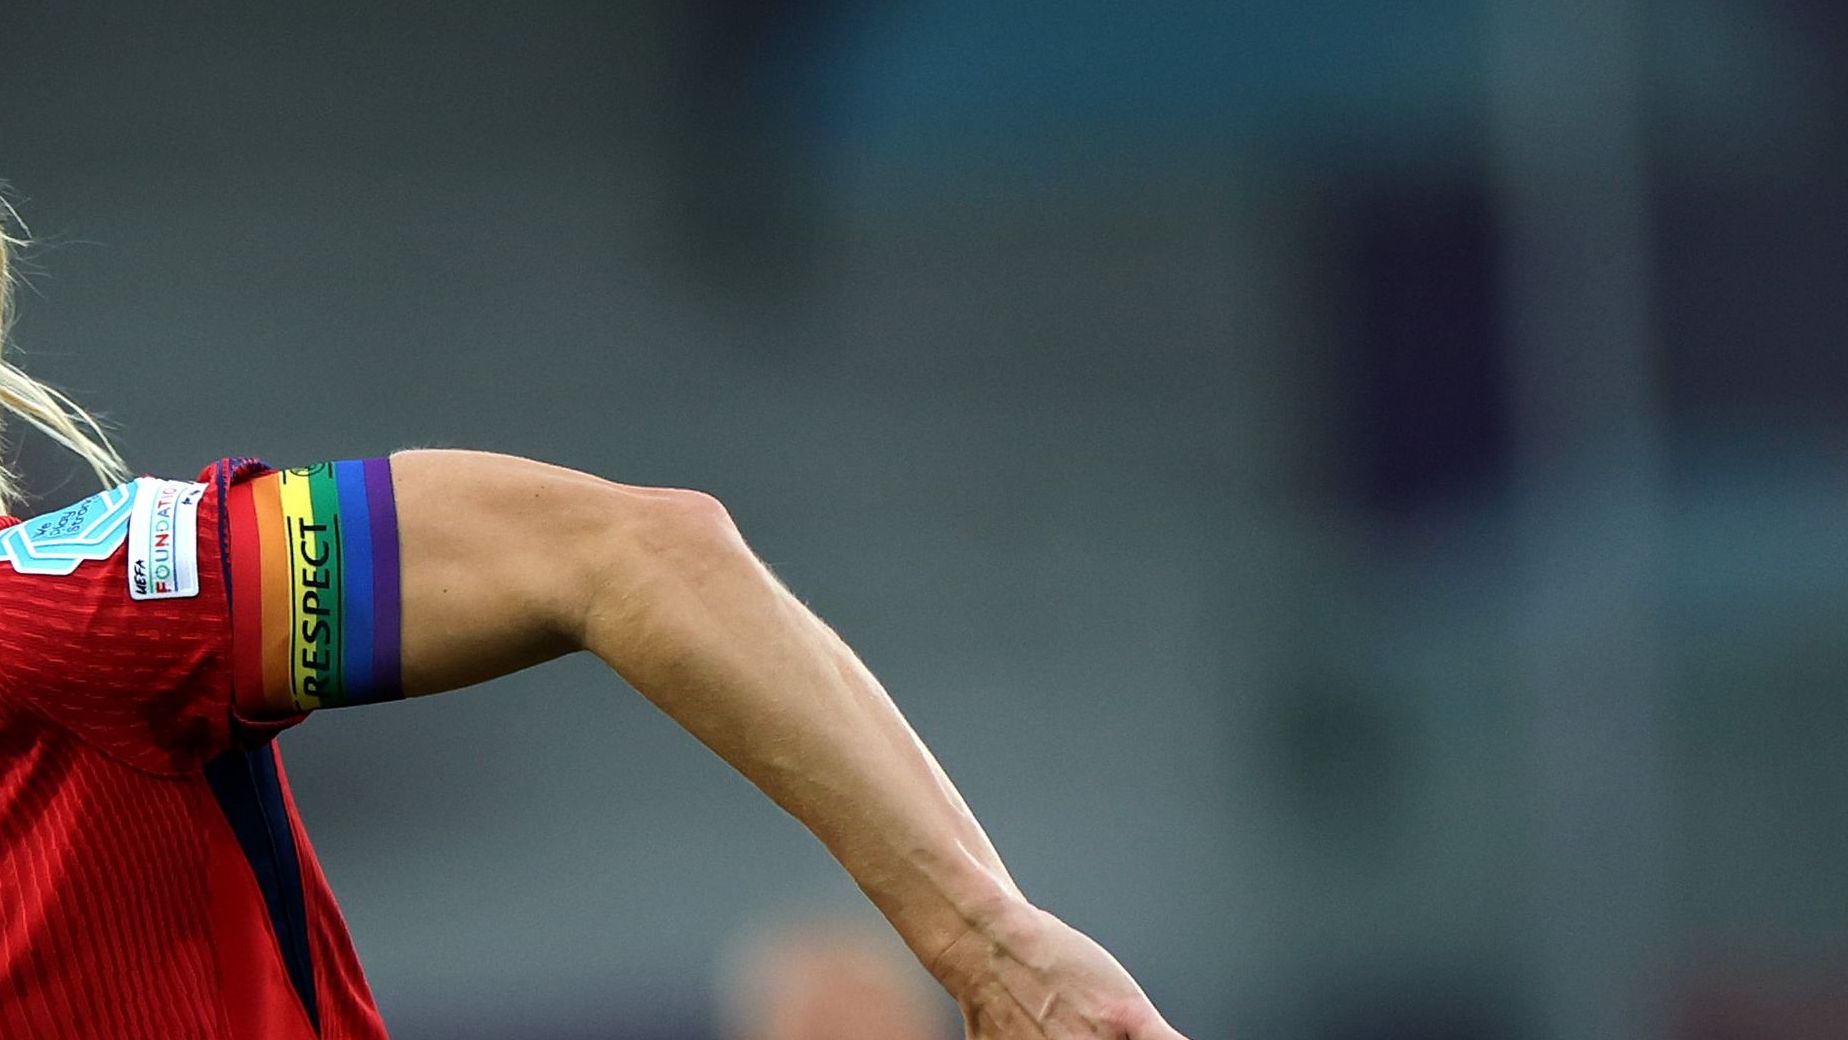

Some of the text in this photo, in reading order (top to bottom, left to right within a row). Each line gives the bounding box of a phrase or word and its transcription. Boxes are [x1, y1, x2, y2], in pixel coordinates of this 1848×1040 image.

[134, 559, 148, 595] UEFA
[155, 484, 177, 593] FOUNDATIO
[300, 517, 331, 697] RESPECT
